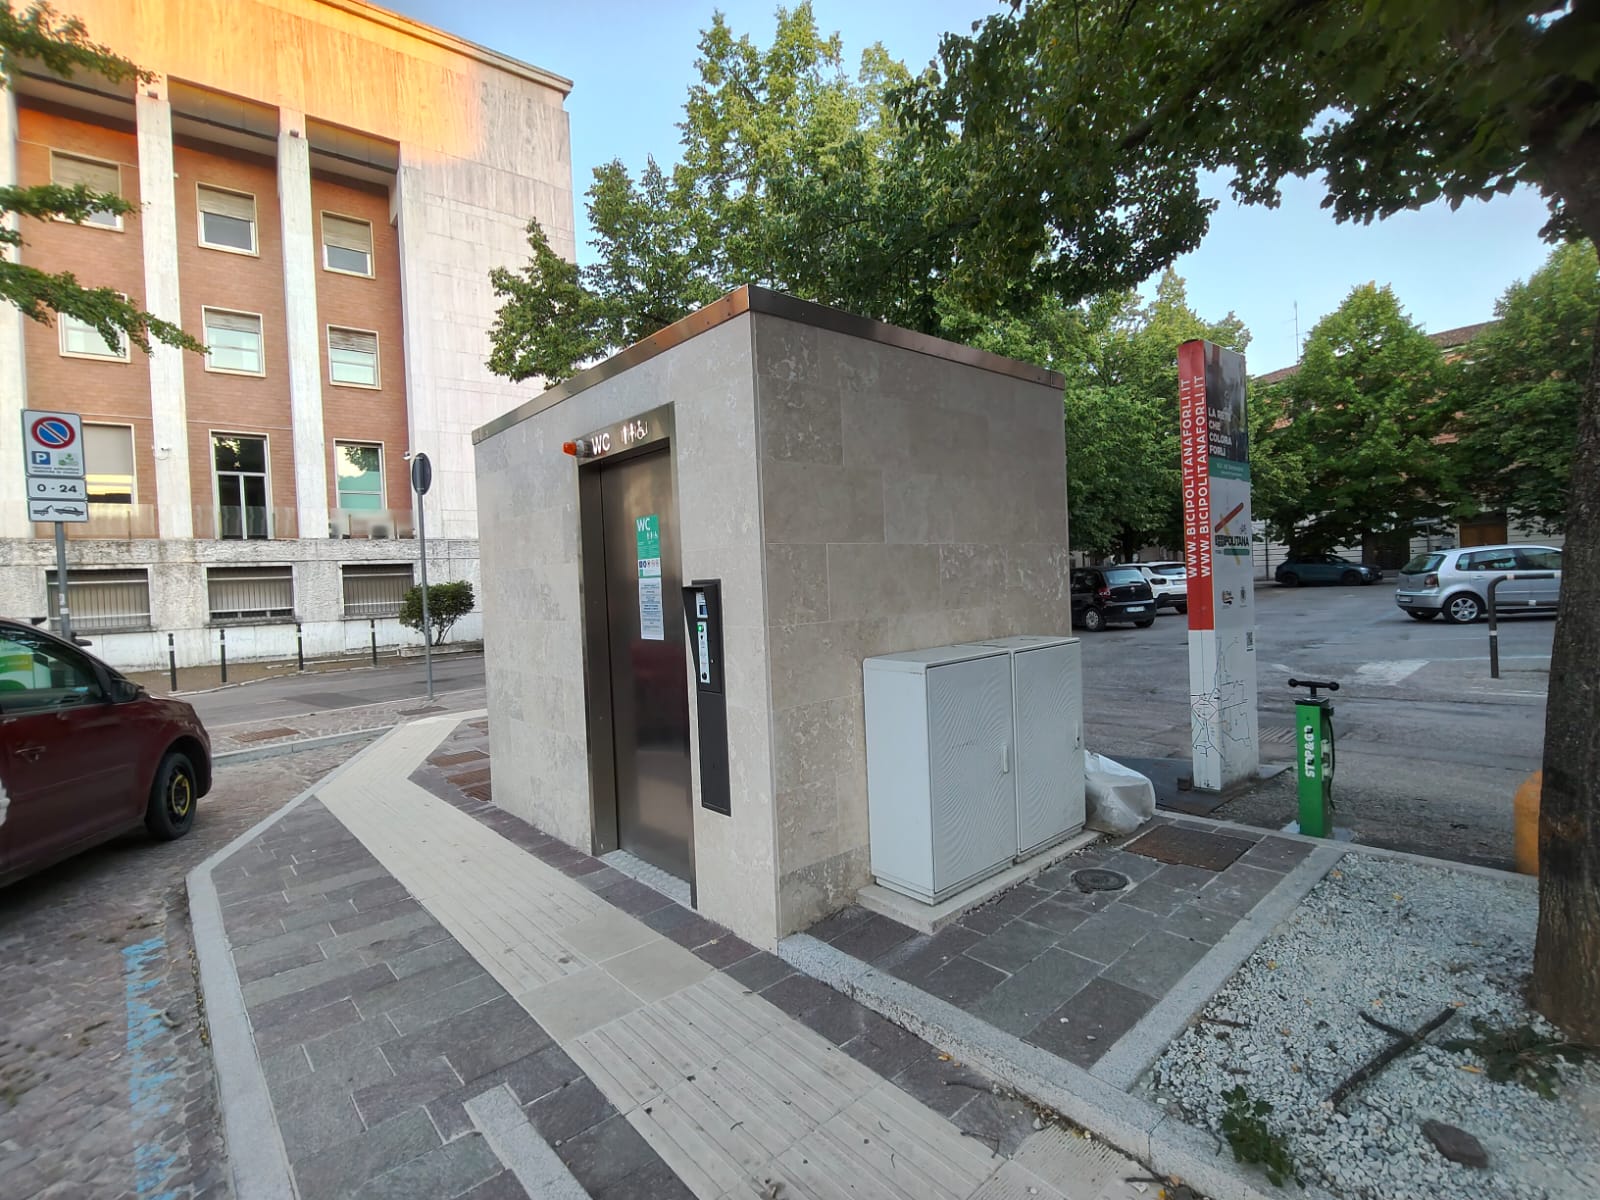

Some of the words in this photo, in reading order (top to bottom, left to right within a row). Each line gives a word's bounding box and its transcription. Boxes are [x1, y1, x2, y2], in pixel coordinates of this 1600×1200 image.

[1208, 407, 1217, 418] LA
[592, 433, 611, 455] WC
[1209, 431, 1232, 446] COLORA
[1181, 379, 1198, 578] WWW.BICIPOLITANAFORLI.IT
[1194, 375, 1211, 578] WWW.BICIPOLITANAFORLI.IT
[59, 484, 77, 493] 24
[636, 517, 651, 532] WC
